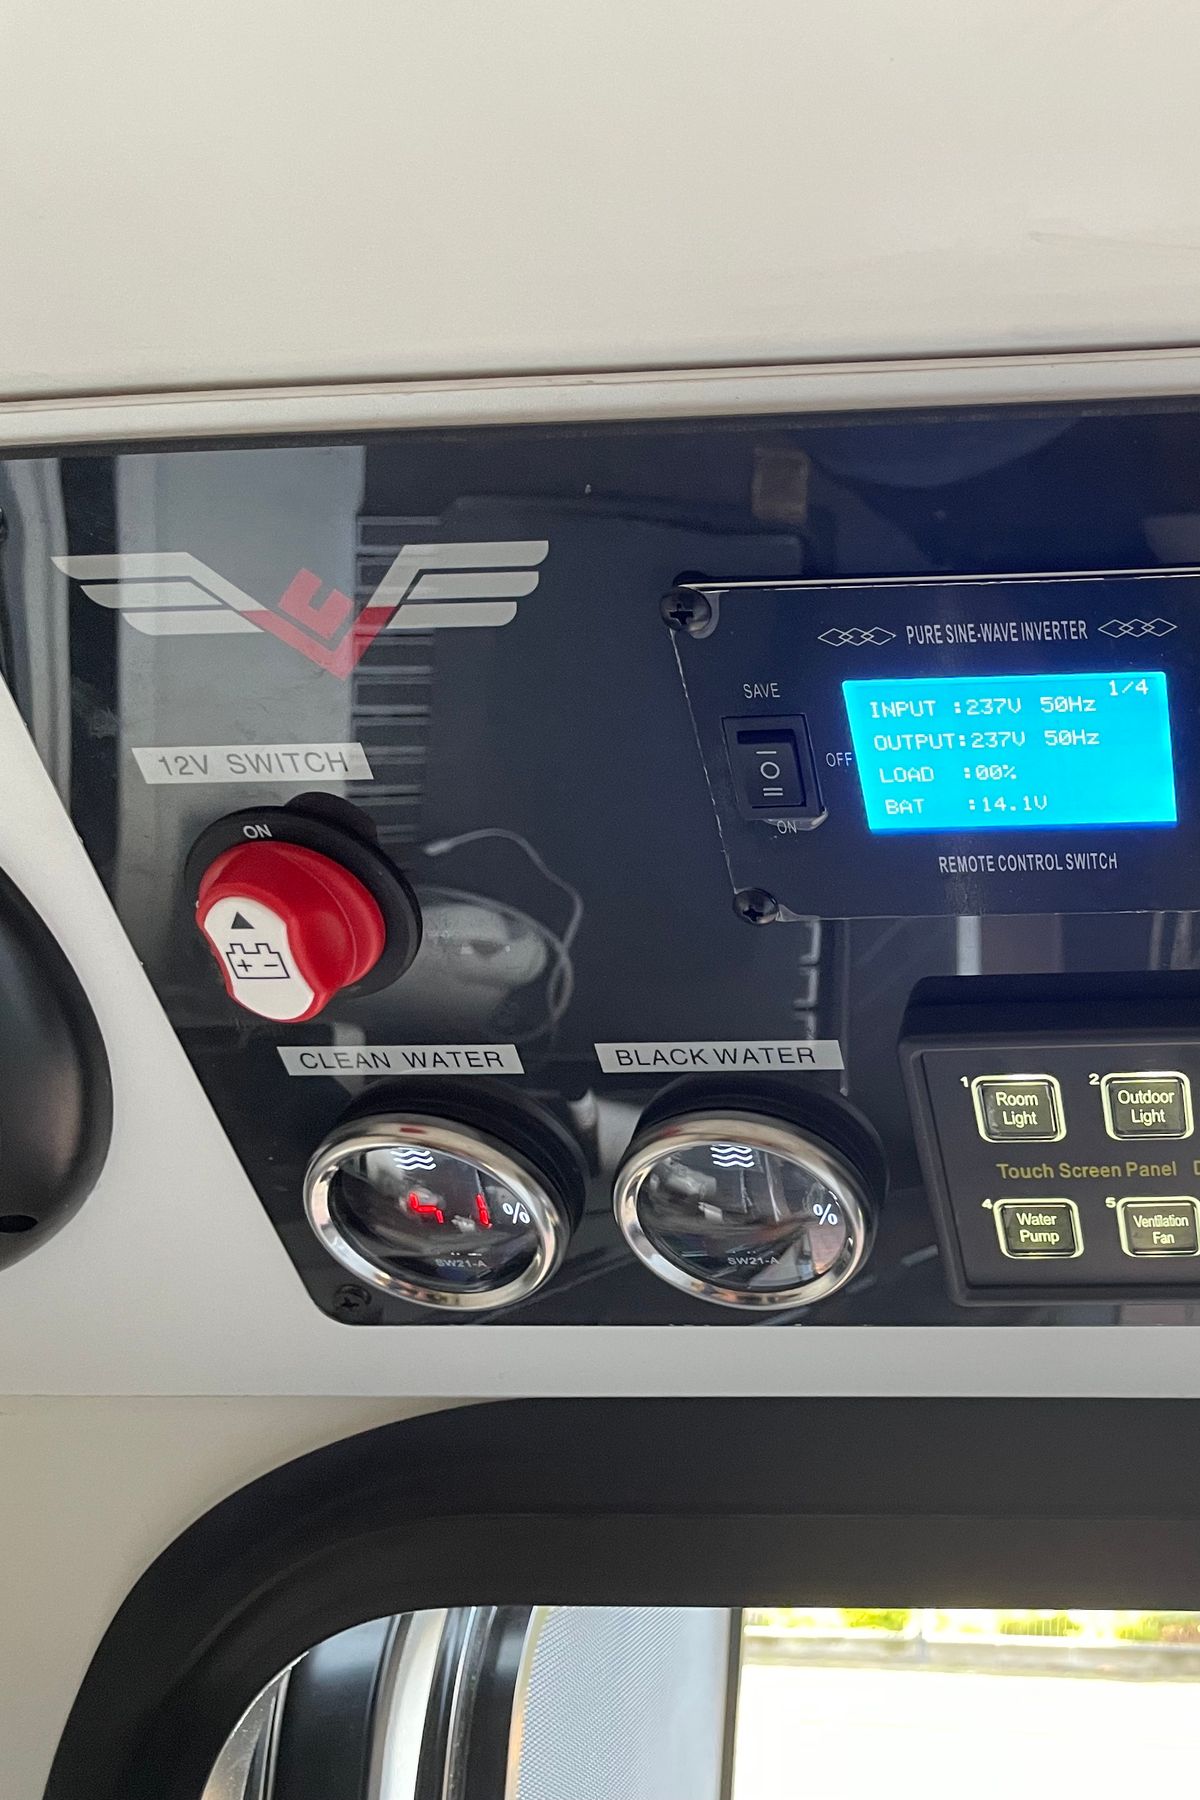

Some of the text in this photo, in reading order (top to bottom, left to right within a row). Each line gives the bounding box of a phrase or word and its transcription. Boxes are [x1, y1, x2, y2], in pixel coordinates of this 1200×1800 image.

[906, 620, 1088, 645] PURE SINE-WAVE INVERTER
[743, 683, 780, 699] SAVE
[1108, 678, 1149, 697] 1/4
[869, 700, 936, 719] INPUT
[1040, 696, 1097, 714] 50Hz
[1044, 729, 1101, 746] 50Hz
[157, 750, 350, 777] 12V SWITCH
[825, 752, 853, 767] OFF
[879, 766, 935, 784] LOAD
[885, 797, 925, 815] BAT
[243, 822, 273, 840] ON
[776, 820, 798, 834] ON
[938, 852, 1118, 873] REMOTE CONTROL SWITCH
[298, 1049, 504, 1071] CLEAN WATER
[615, 1045, 817, 1067] BLACK WATER
[960, 1076, 969, 1088] 1
[1089, 1074, 1100, 1085] 2
[995, 1091, 1039, 1107] Room
[1117, 1089, 1175, 1105] Outdoor
[1003, 1110, 1038, 1128] Light
[1131, 1108, 1166, 1126] Light
[996, 1163, 1054, 1179] Touch
[1059, 1162, 1121, 1178] Screen
[1126, 1161, 1177, 1177] Panel
[982, 1198, 993, 1210] 4
[1106, 1197, 1116, 1208] 5
[503, 1202, 531, 1224] %
[812, 1203, 838, 1226] %
[1016, 1212, 1057, 1227] Water
[1133, 1213, 1189, 1228] Ventilation
[1020, 1230, 1060, 1245] Pump
[1153, 1231, 1175, 1245] Fan
